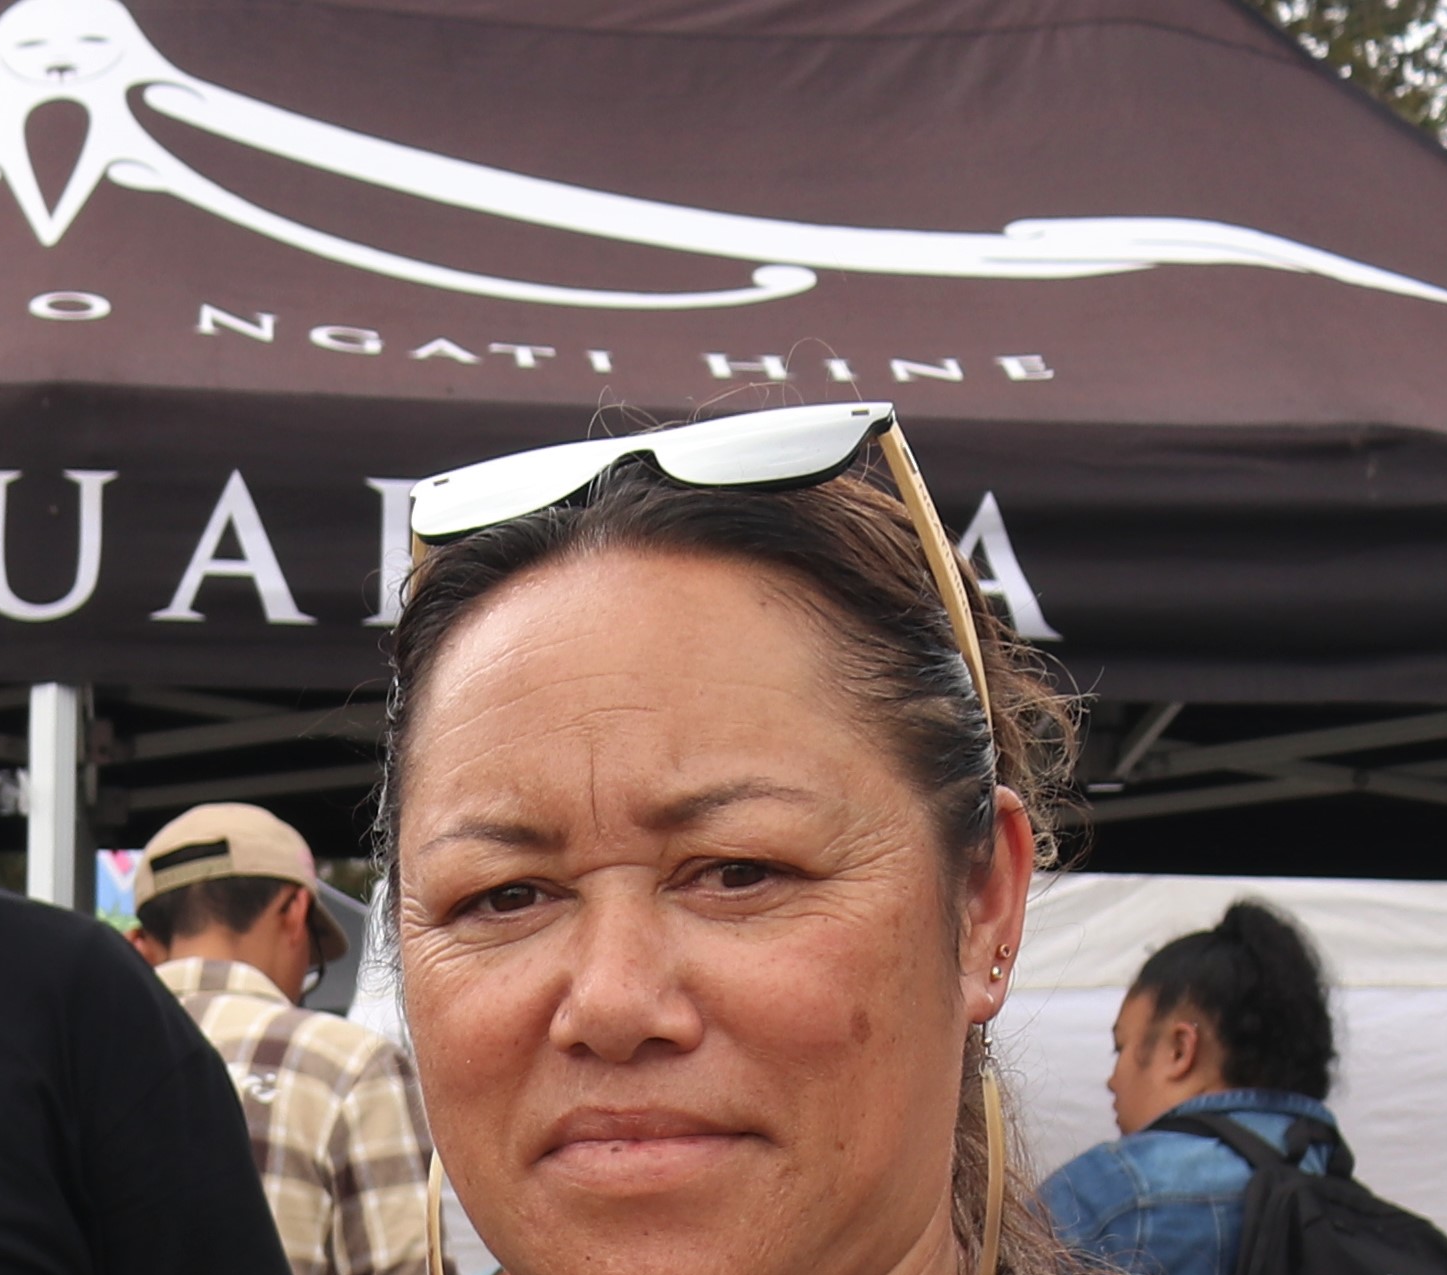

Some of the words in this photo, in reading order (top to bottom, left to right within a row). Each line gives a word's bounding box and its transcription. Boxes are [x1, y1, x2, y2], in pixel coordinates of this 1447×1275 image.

[28, 292, 112, 320] O
[195, 303, 614, 374] NGATI
[704, 351, 1055, 382] HINE
